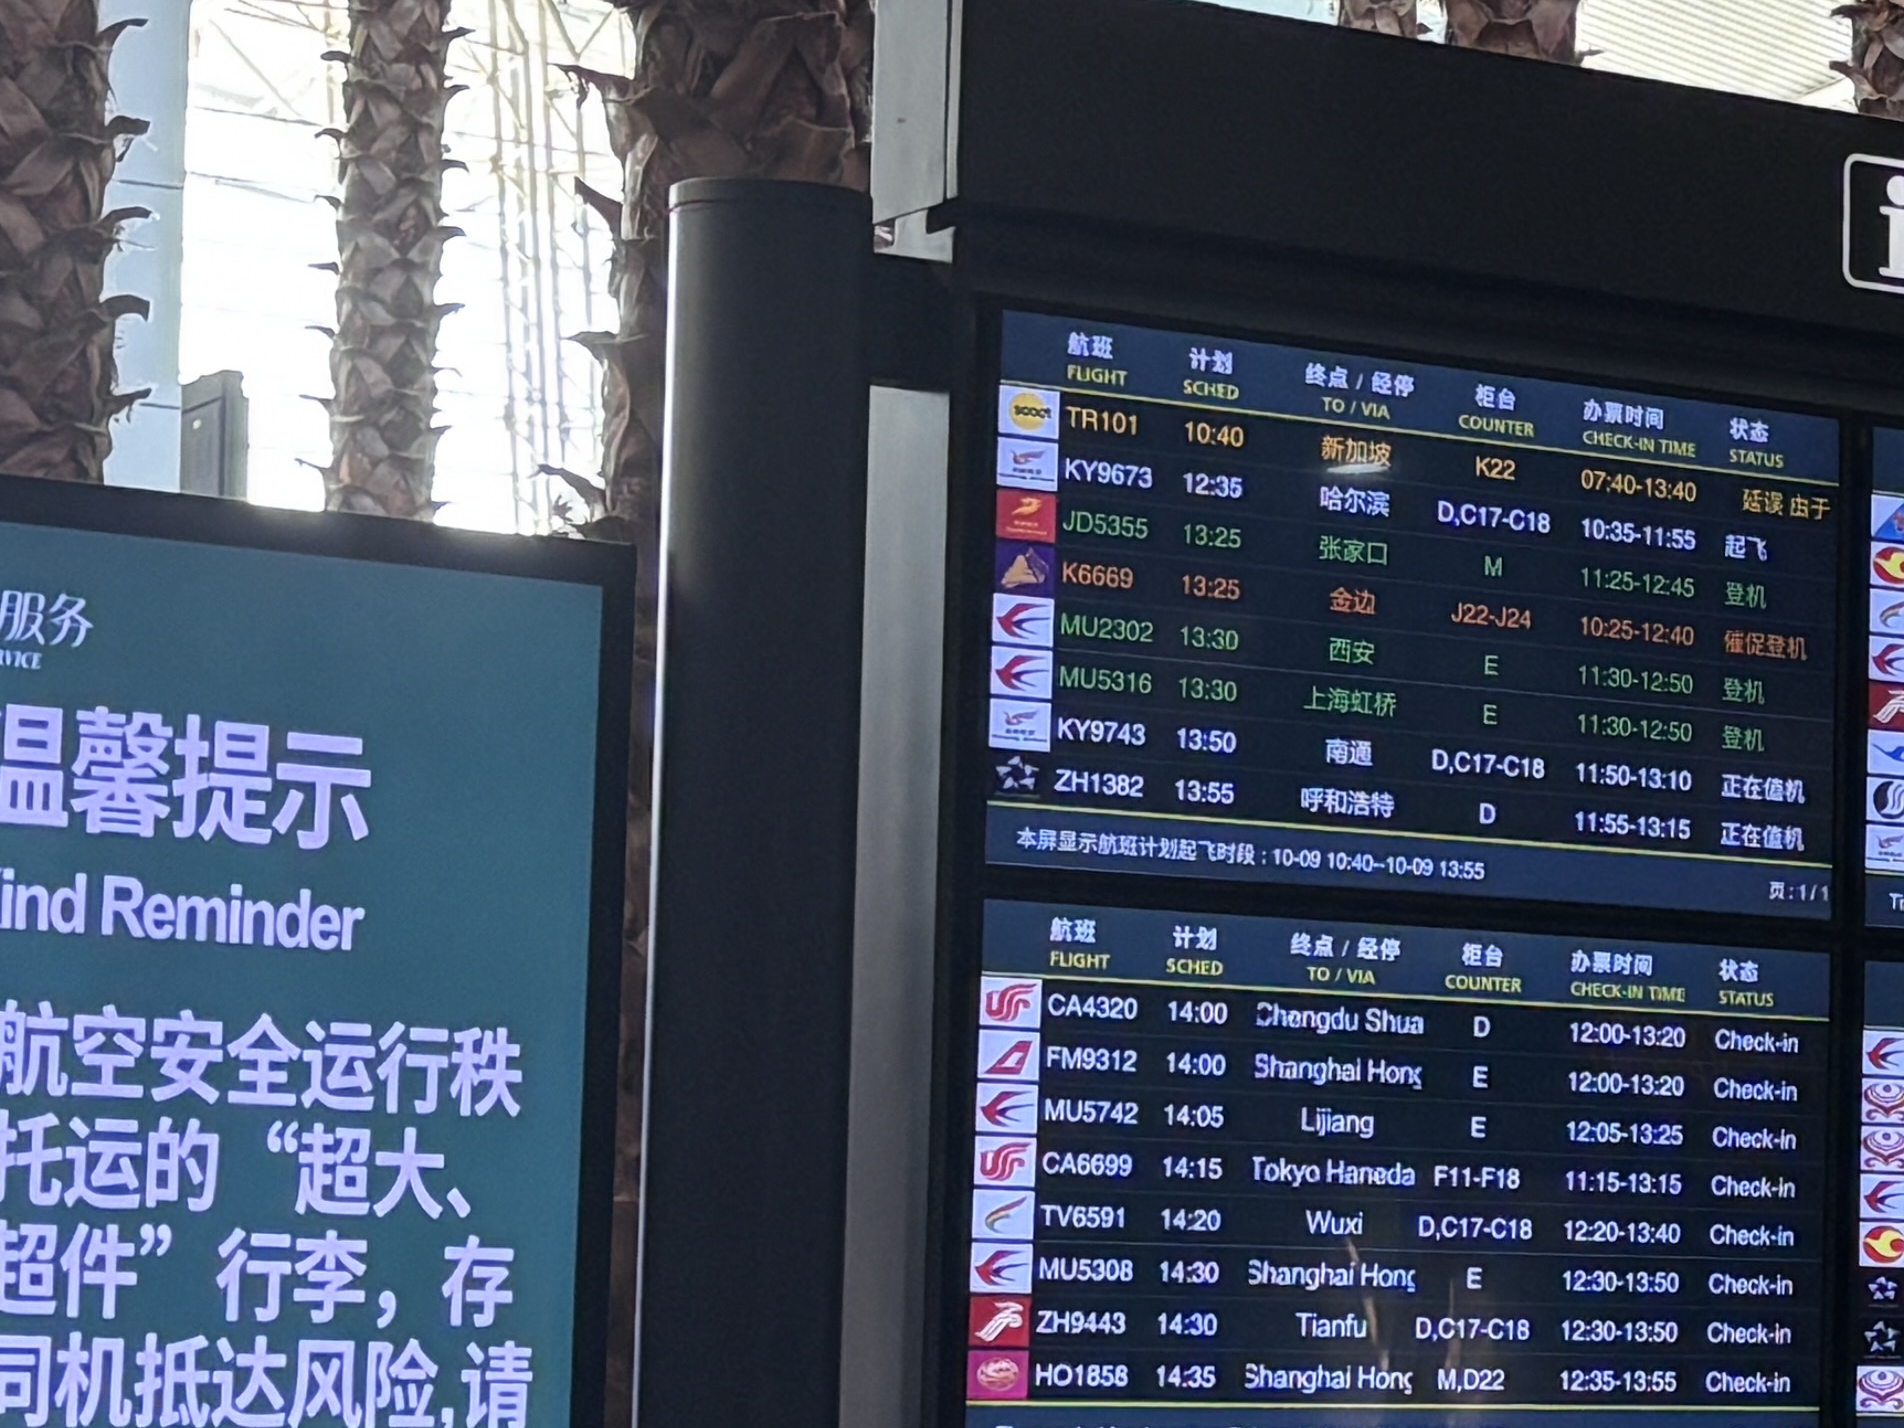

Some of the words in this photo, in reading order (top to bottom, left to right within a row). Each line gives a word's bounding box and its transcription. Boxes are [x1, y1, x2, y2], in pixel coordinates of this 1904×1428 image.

[1068, 331, 1113, 359] 航班
[1188, 347, 1233, 375] 计划
[1475, 384, 1516, 411] 柜台
[1583, 398, 1664, 430] 办票时间
[1730, 417, 1769, 443] 状态
[1067, 406, 1136, 435] TR101
[1185, 421, 1244, 447] 10:40
[1322, 435, 1391, 468] 新加坡
[1065, 458, 1153, 489] KY9673
[1183, 472, 1243, 499] 12:35
[1320, 486, 1390, 517] 哈尔滨
[1063, 511, 1148, 538] JD5355
[1185, 524, 1241, 548] 13:25
[1319, 535, 1387, 565] 张家口
[1063, 562, 1133, 588] K6669
[1183, 575, 1239, 599] 13:25
[1330, 587, 1375, 614] 金边
[1061, 614, 1153, 642] MU2302
[1181, 626, 1239, 650] 13:30
[1330, 637, 1374, 664] 西安
[1060, 666, 1152, 694] MU5316
[1179, 678, 1237, 701] 13:30
[1304, 686, 1396, 717] 上海虹桥
[1058, 717, 1146, 746] KY9743
[1177, 728, 1237, 754] 13:50
[1325, 737, 1373, 766] 南通
[0, 703, 373, 850] 温馨提示
[1053, 769, 1144, 798] ZH1382
[1175, 779, 1235, 804] 13:55
[1300, 787, 1395, 818] 呼和浩特
[0, 866, 87, 935] ind
[101, 875, 366, 952] Reminder
[1048, 993, 1138, 1020] CA4320
[1168, 1001, 1228, 1024] 14:00
[0, 998, 523, 1118] 航空安全运行秩
[1047, 1046, 1137, 1072] FM9312
[1166, 1052, 1226, 1076] 14:00
[1045, 1099, 1138, 1125] MU5742
[1164, 1104, 1224, 1128] 14:05
[1043, 1151, 1133, 1177] CA6699
[1163, 1156, 1223, 1180] 14:15
[1040, 1204, 1125, 1228] TV6591
[1161, 1208, 1222, 1231] 14:20
[1039, 1257, 1134, 1282] MU5308
[1160, 1260, 1219, 1284] 14:30
[1036, 1310, 1126, 1334] ZH9443
[1158, 1312, 1218, 1336] 14:30
[1036, 1363, 1129, 1387] HO1858
[1156, 1364, 1216, 1388] 14:35
